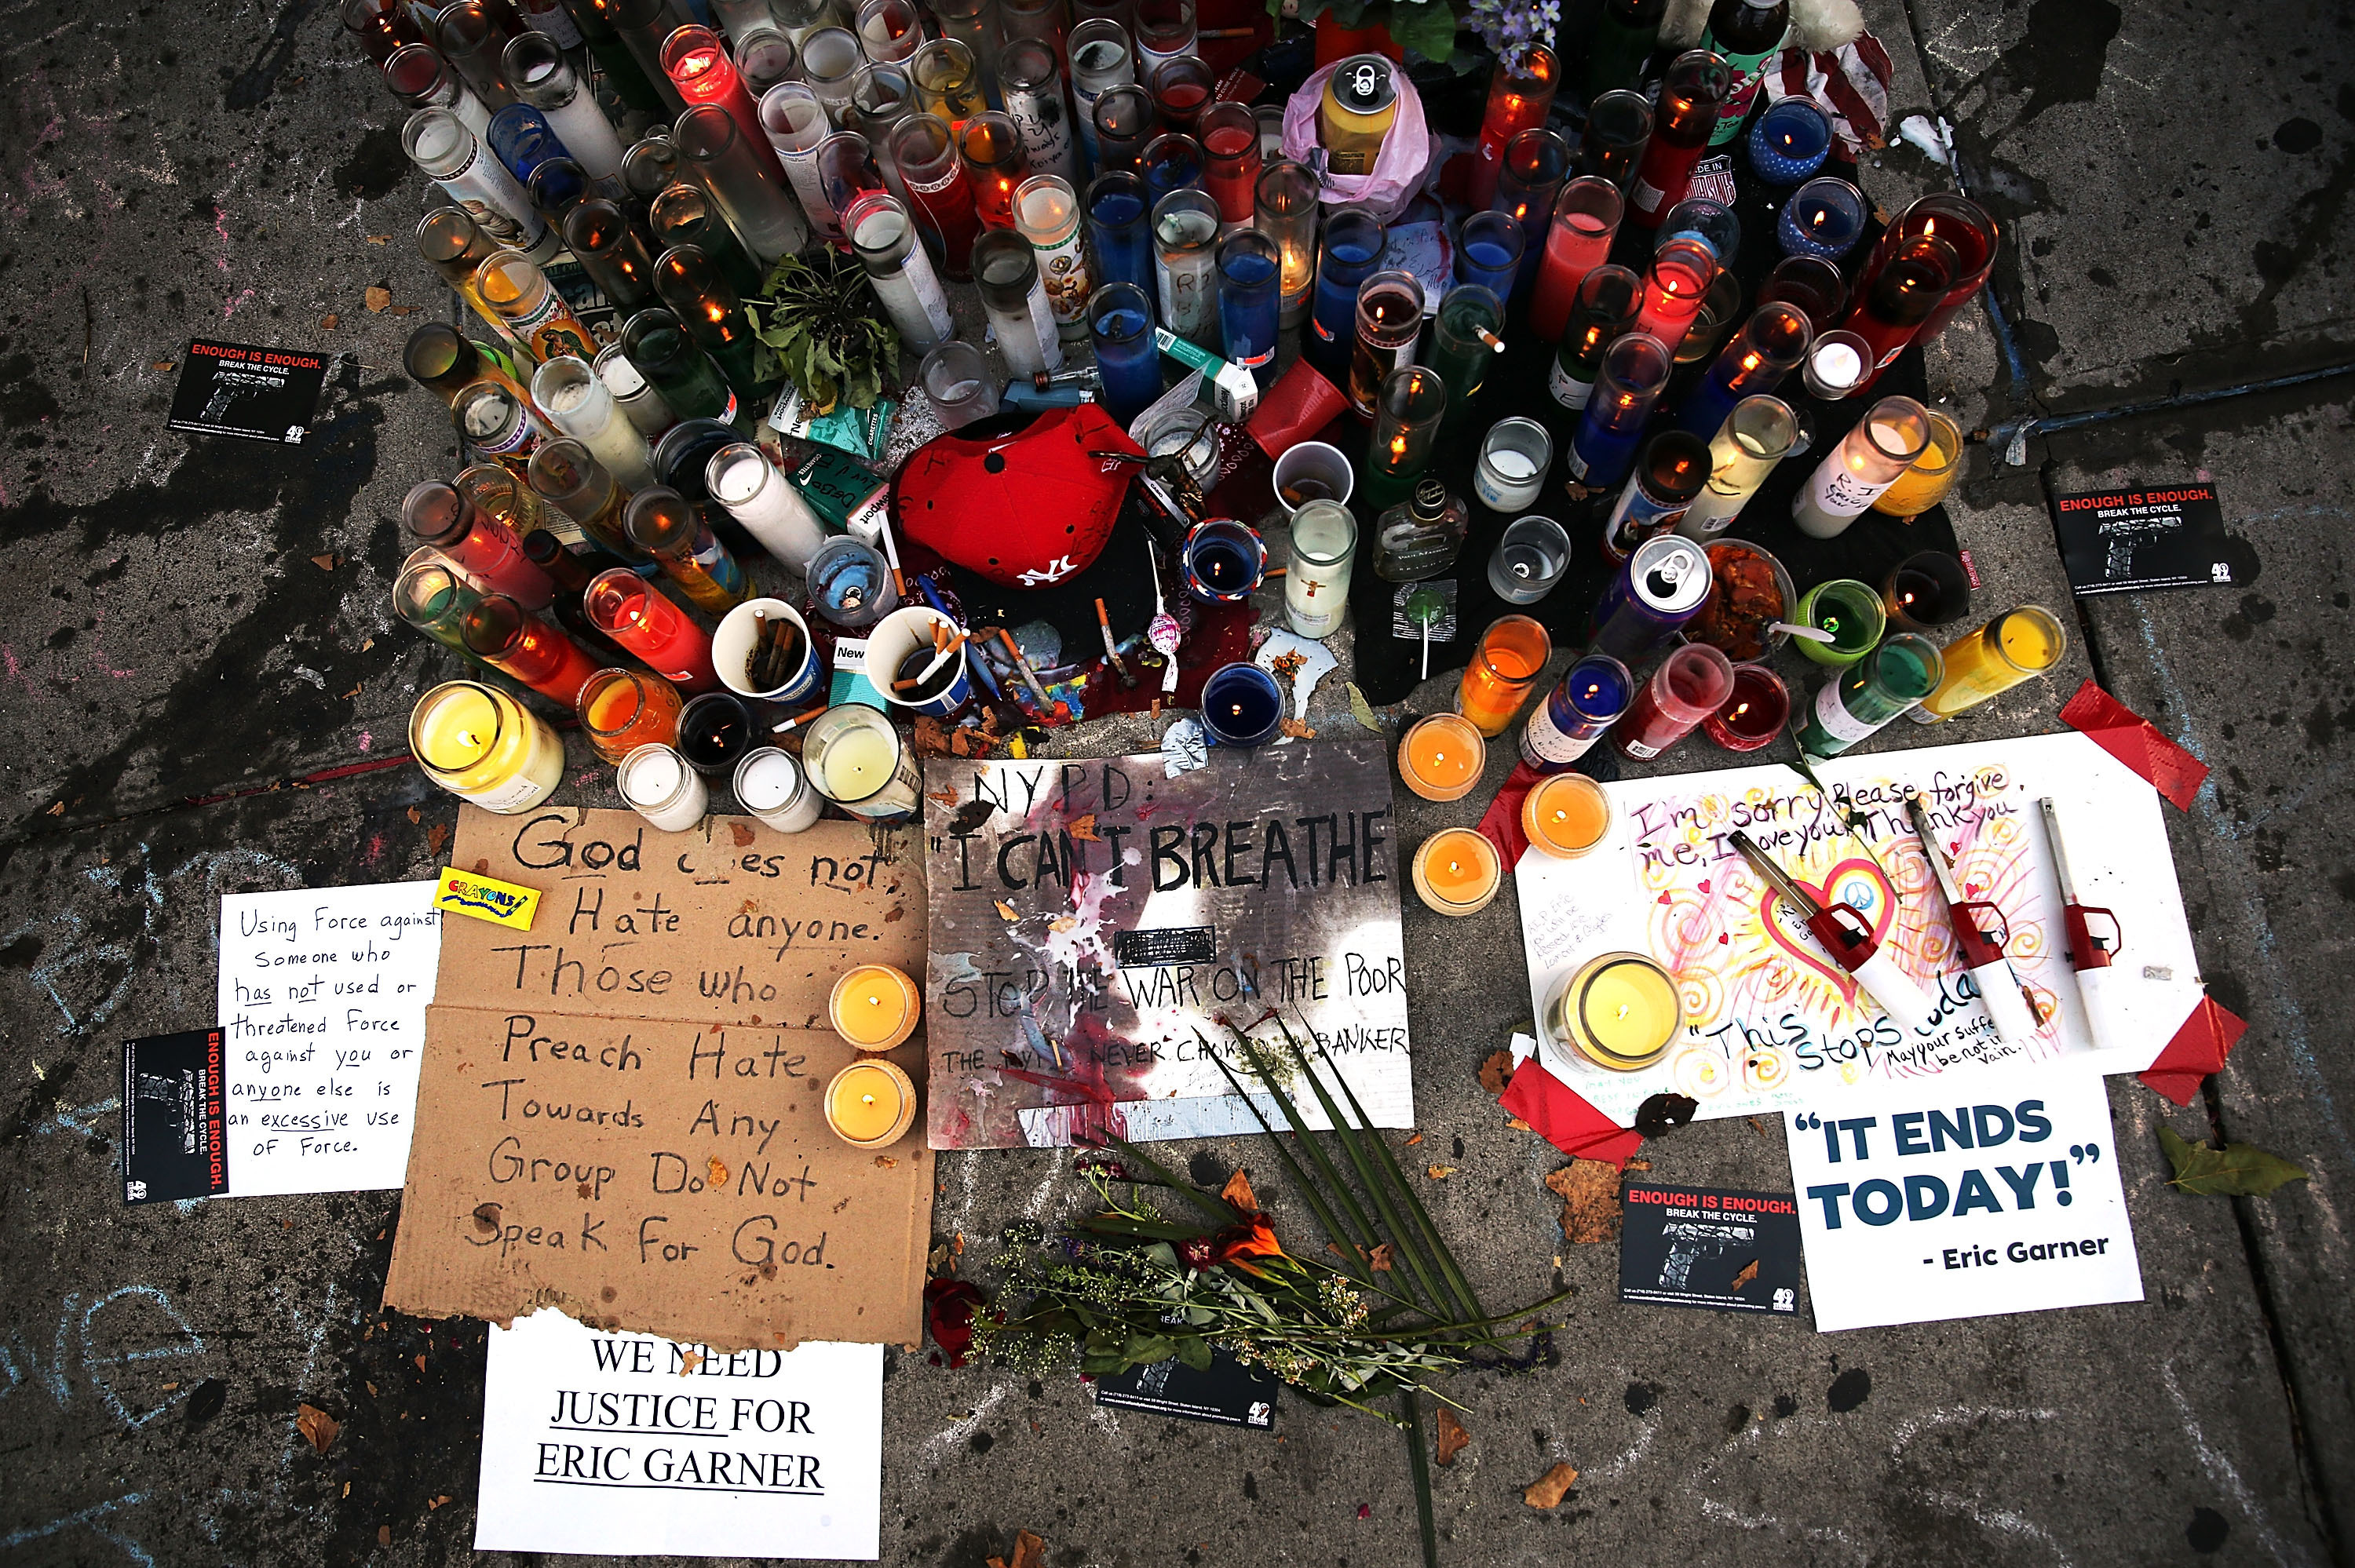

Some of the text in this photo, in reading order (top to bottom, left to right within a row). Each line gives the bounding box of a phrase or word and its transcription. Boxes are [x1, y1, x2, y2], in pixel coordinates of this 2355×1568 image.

[192, 344, 322, 370] ENOUGH IS ENOUGH.
[218, 360, 290, 375] BREAK THE CYCLE.
[867, 413, 878, 446] CIGARETTES
[860, 491, 890, 524] ewport
[2060, 489, 2213, 512] ENOUGH IS ENOUGH.
[2098, 505, 2182, 518] BREAK THE CYCLE.
[1630, 800, 1713, 843] I'm
[1757, 830, 1794, 851] ove
[1865, 804, 1974, 843] Thnk
[512, 814, 644, 870] God
[448, 880, 517, 907] CRAYONS
[241, 908, 297, 943] Using
[380, 906, 440, 941] against
[568, 886, 880, 961] Hate anyone.
[352, 940, 391, 963] who
[235, 973, 417, 1005] has not used or
[491, 944, 778, 1005] Those who
[1123, 965, 1199, 1010] WAR
[1213, 966, 1261, 1004] ON
[1271, 956, 1329, 1003] THE
[231, 1012, 327, 1039] threatened
[246, 1042, 414, 1074] against you or
[502, 1014, 807, 1081] Preach Hate
[942, 1049, 985, 1073] THE
[1090, 1041, 1166, 1067] NEVER
[1935, 1053, 1962, 1067] be
[198, 1069, 206, 1101] BREAK
[232, 1078, 391, 1102] anyone else is
[207, 1032, 222, 1190] ENOUGH IS ENOUGH.
[228, 1110, 400, 1130] an excessive use
[481, 1078, 781, 1154] Towards Any
[199, 1121, 207, 1155] CYCLE.
[1892, 1099, 2052, 1157] ENDS
[489, 1136, 819, 1202] Group Do Not
[1628, 1189, 1796, 1215] ENOUGH IS ENOUGH.
[1666, 1208, 1758, 1223] BREAK THE CYCLE.
[732, 1214, 836, 1270] God.
[1942, 1244, 1999, 1270] Eric
[2006, 1237, 2109, 1264] Garner
[591, 1339, 782, 1379] WE NEED
[551, 1390, 815, 1435] JUSTICE FOR
[534, 1442, 825, 1490] ERIC GARNER
